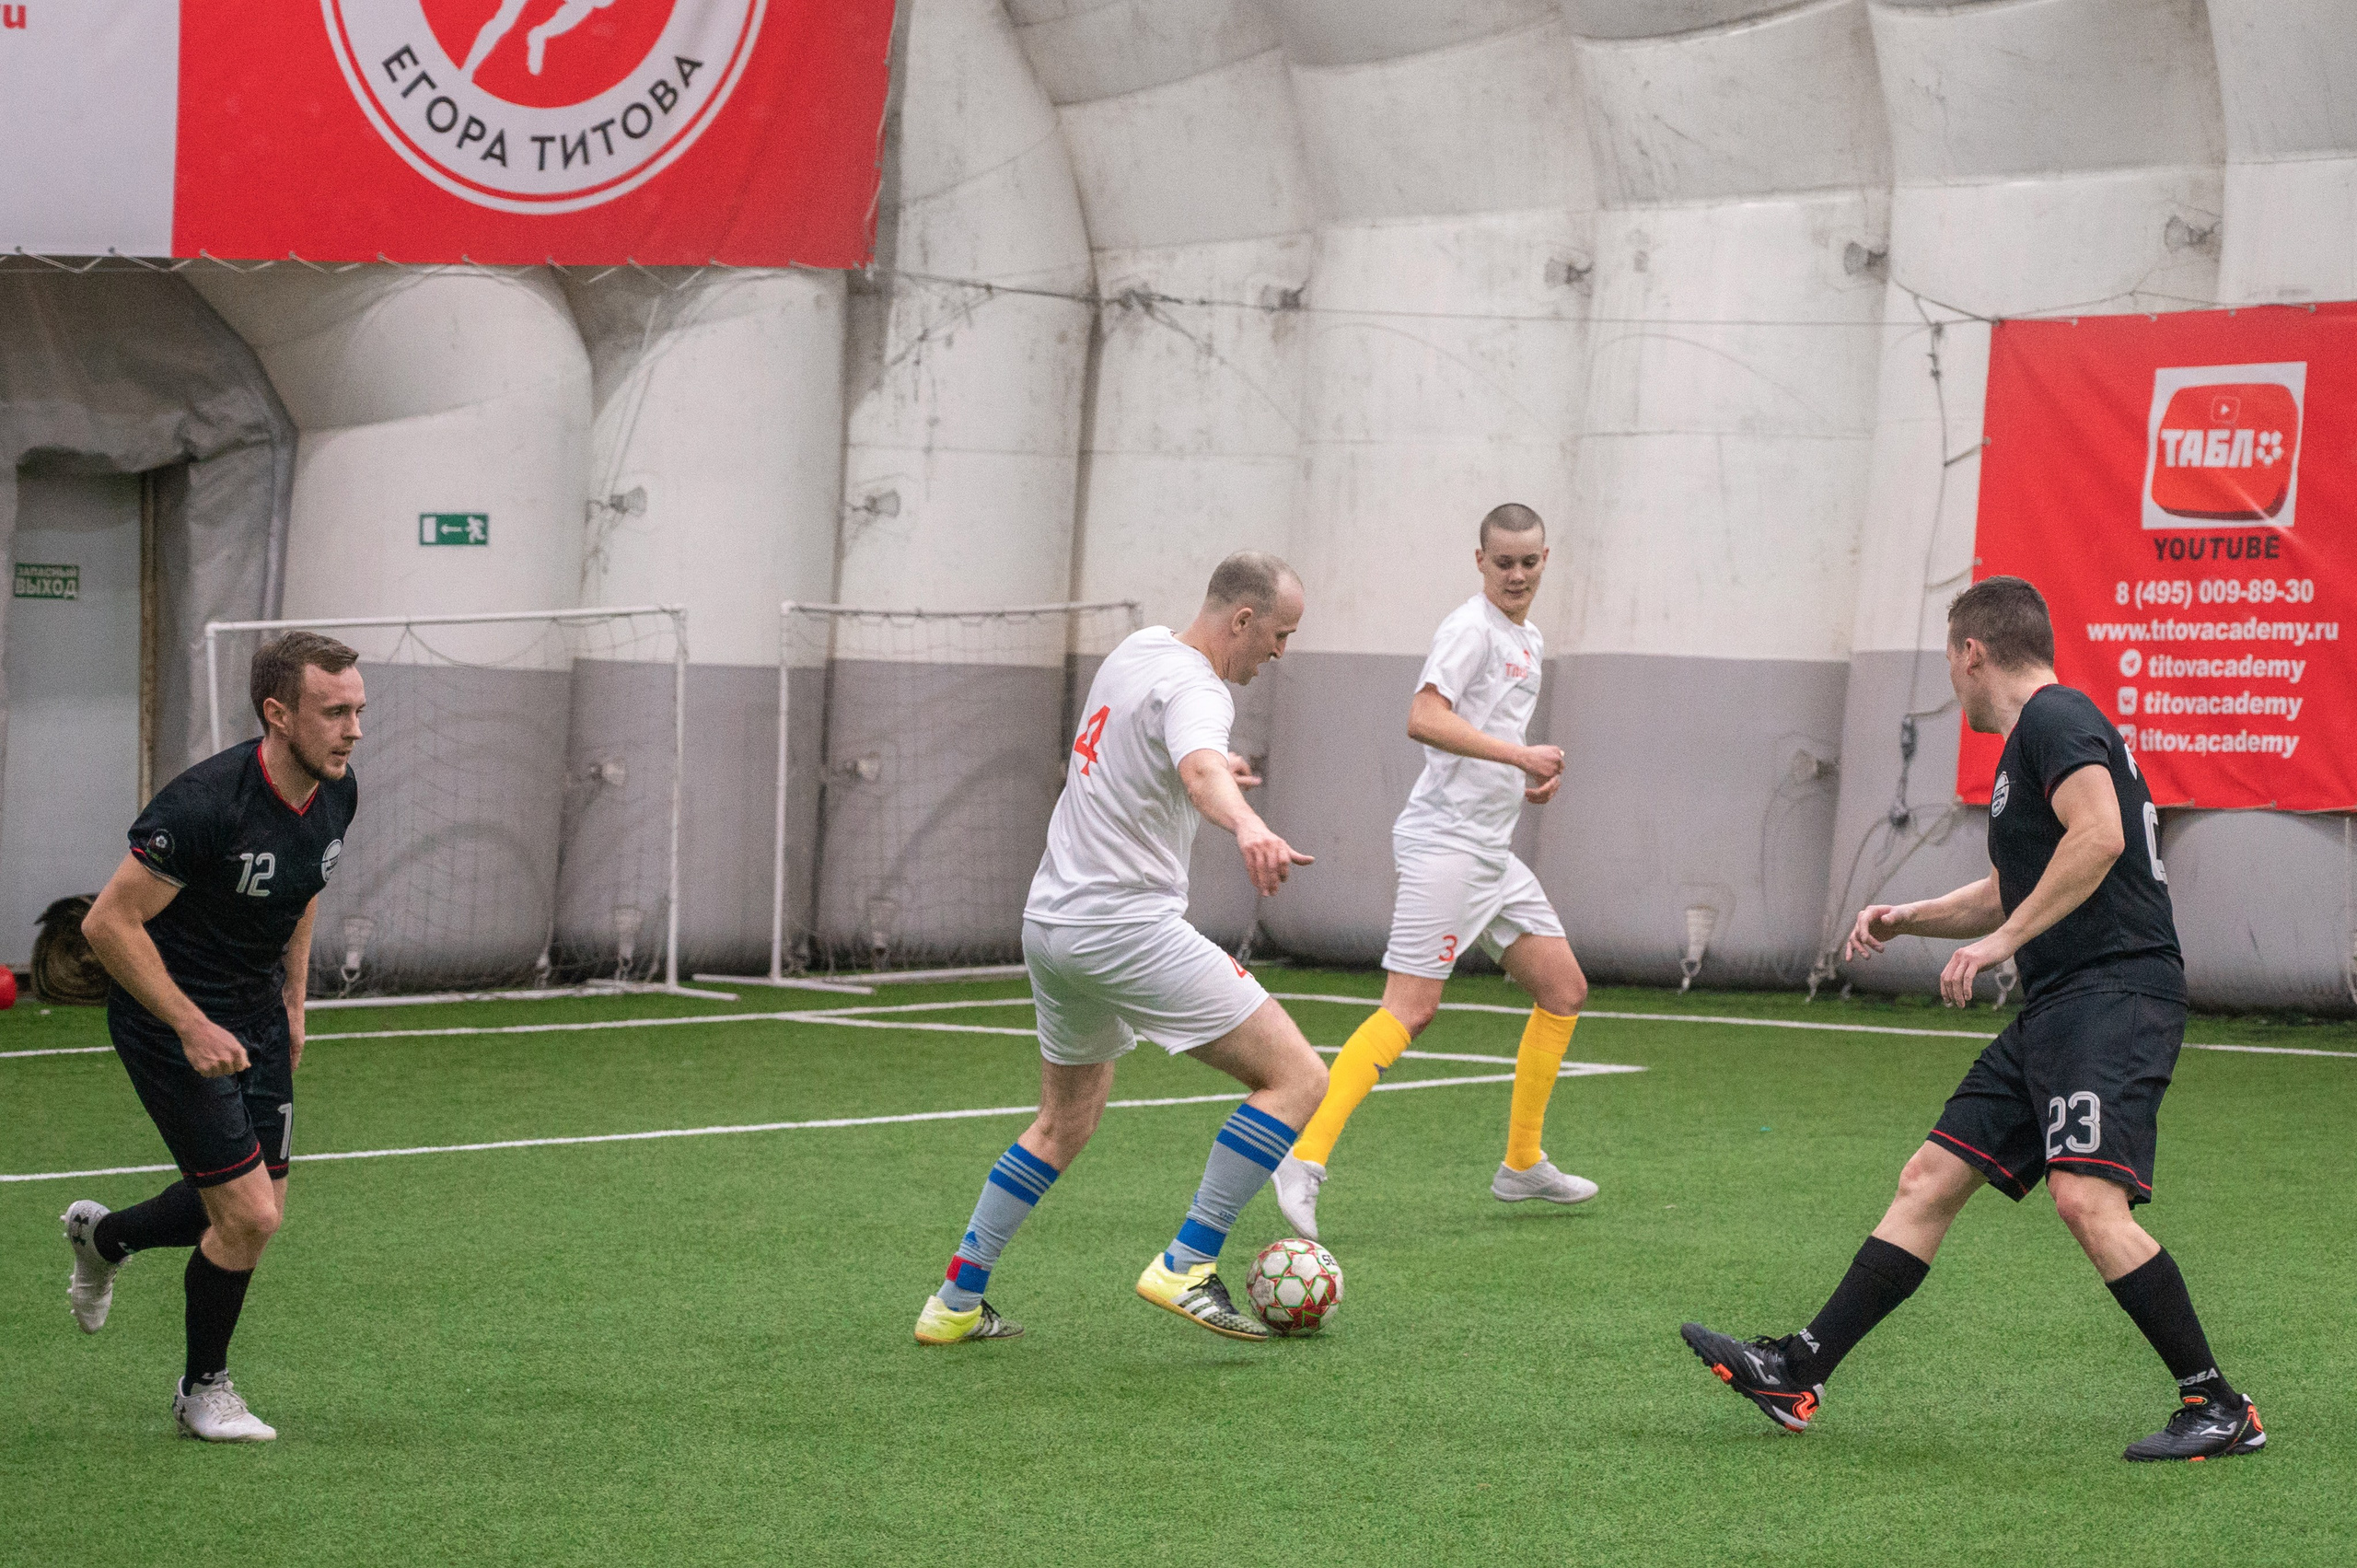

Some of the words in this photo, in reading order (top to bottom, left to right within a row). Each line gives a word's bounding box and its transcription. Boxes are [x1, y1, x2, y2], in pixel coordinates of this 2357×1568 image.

[0, 4, 27, 29] u
[381, 43, 508, 168] ЕГОРА
[530, 55, 704, 171] ТИТОВА
[2154, 535, 2281, 561] YOUTUBE
[16, 578, 78, 601] ВЫХОД
[2115, 580, 2130, 606] 8
[2134, 579, 2193, 610] (495)
[2198, 578, 2315, 604] 009-89-30
[2085, 616, 2340, 646] www.titovacademy.ru
[2147, 653, 2306, 684] titovacademy
[2143, 690, 2304, 722] titovacademy
[1074, 704, 1110, 777] 4
[2140, 727, 2300, 760] titov.academy
[235, 852, 276, 898] 12
[1438, 935, 1457, 962] 3
[2046, 1090, 2101, 1160] 23
[1321, 1253, 1339, 1267] SE
